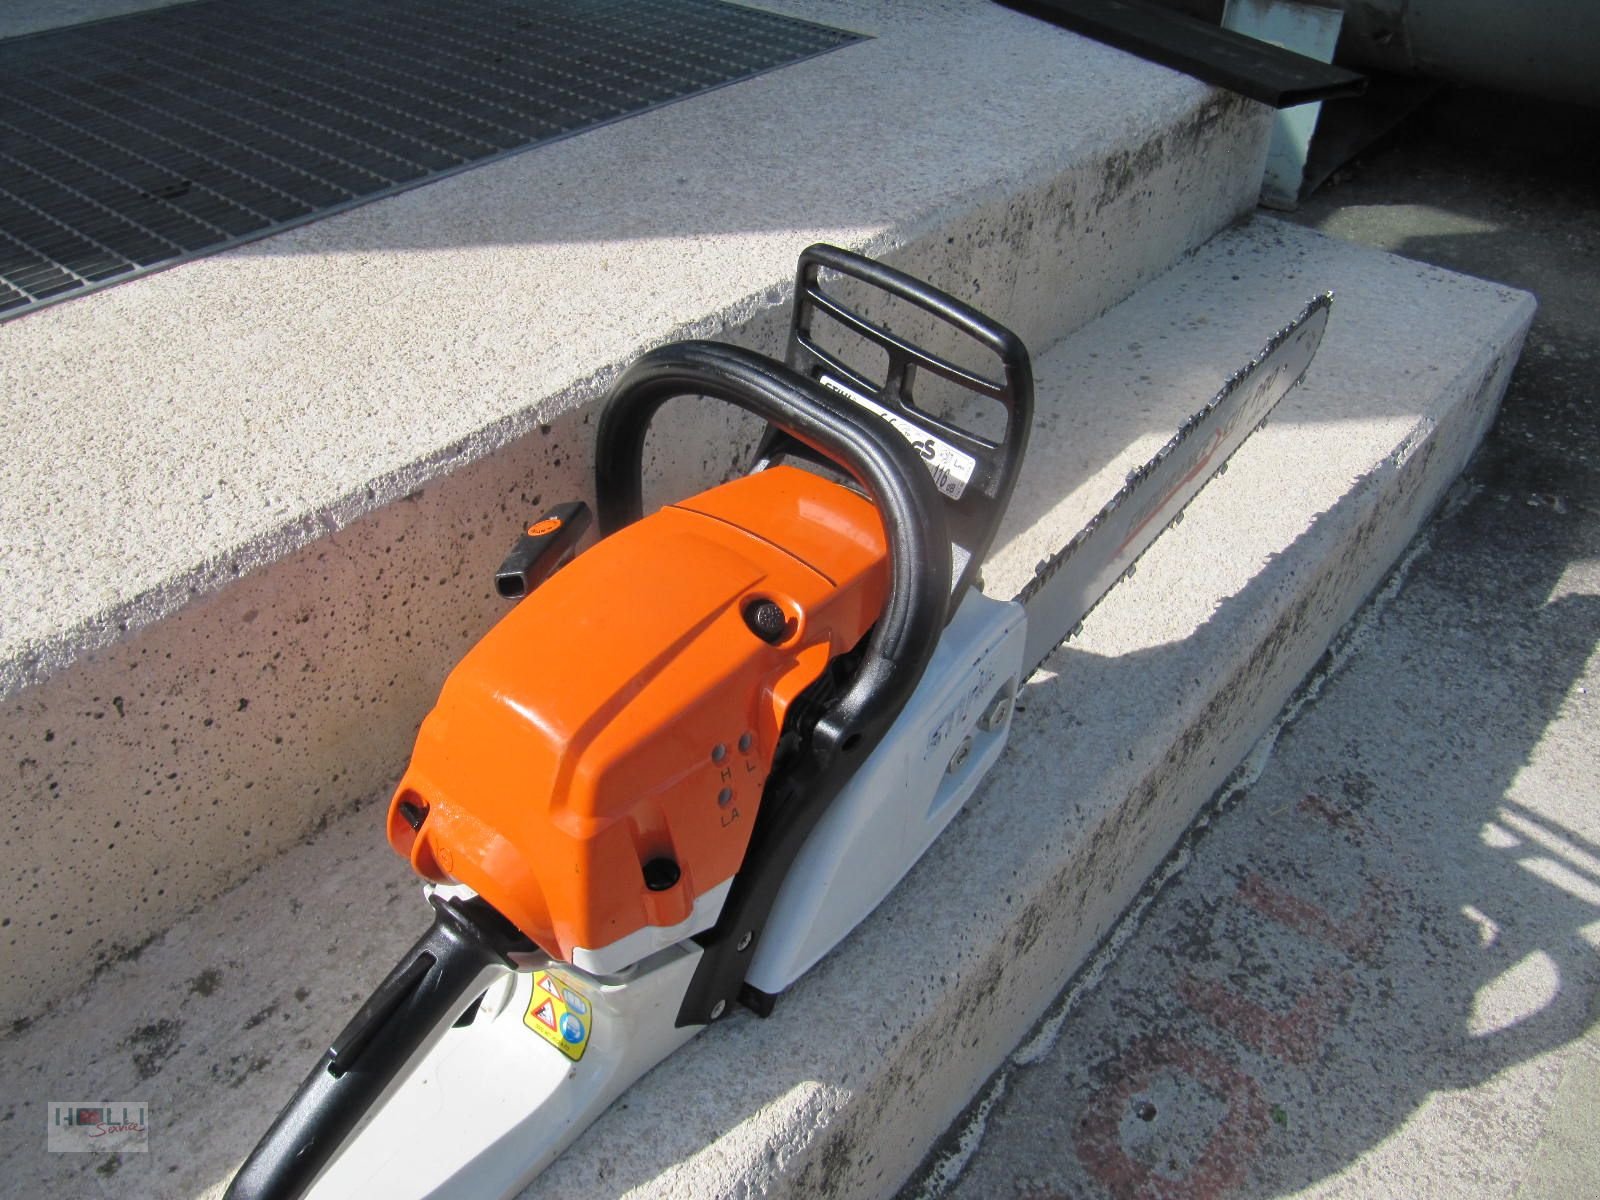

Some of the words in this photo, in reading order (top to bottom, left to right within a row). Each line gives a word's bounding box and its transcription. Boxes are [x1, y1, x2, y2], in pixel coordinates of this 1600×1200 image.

[933, 464, 949, 488] 116
[720, 767, 732, 782] H
[745, 761, 756, 772] L
[720, 807, 740, 828] LA
